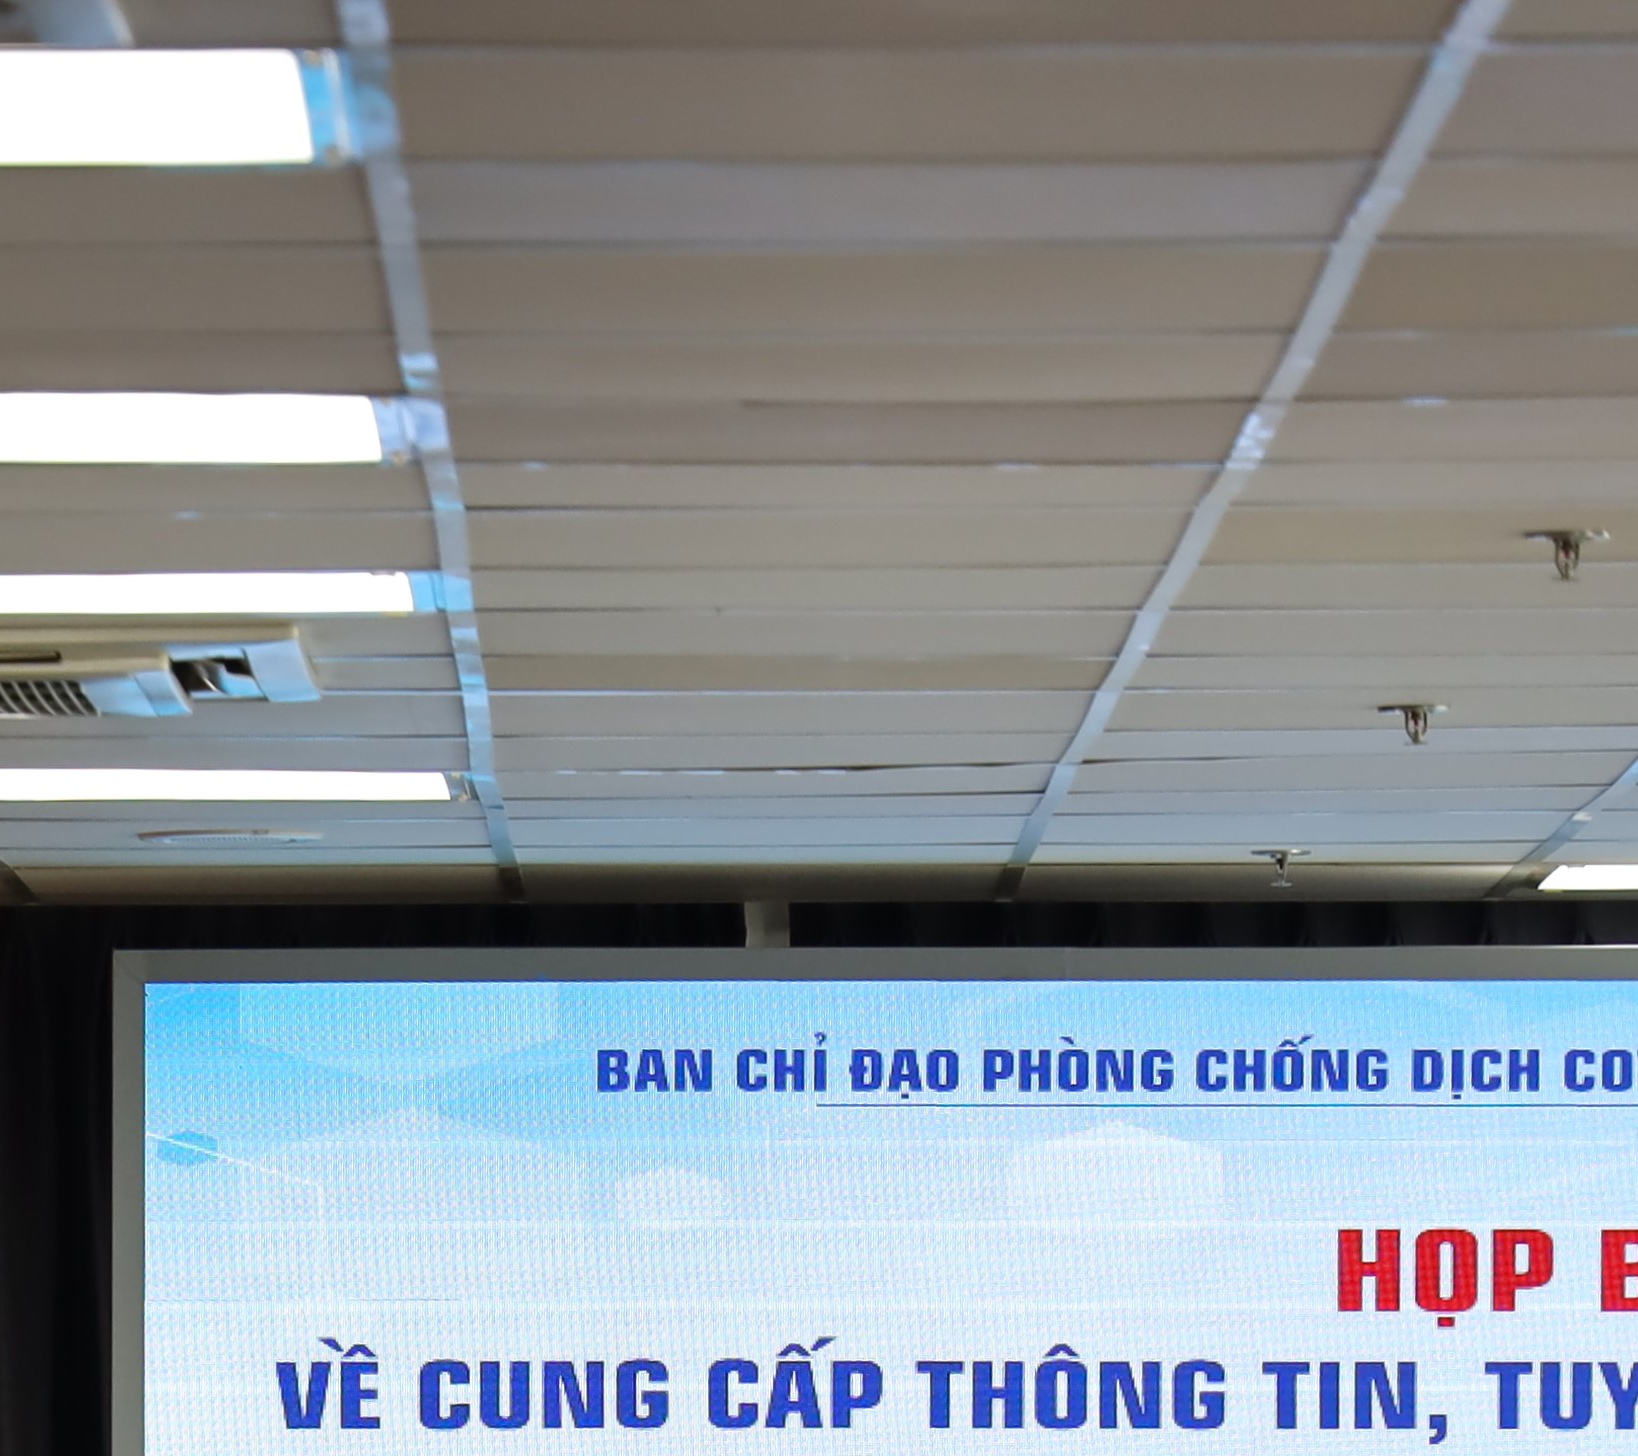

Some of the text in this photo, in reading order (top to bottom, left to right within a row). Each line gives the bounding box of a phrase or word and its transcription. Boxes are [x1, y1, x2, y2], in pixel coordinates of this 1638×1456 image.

[595, 1048, 713, 1093] BAN
[735, 1031, 828, 1092] CHỈ
[848, 1048, 960, 1099] ĐẠO
[982, 1036, 1175, 1093] PHÒNG
[1194, 1035, 1389, 1092] CHỐNG
[1411, 1048, 1541, 1100] DỊCH
[1337, 1227, 1555, 1328] HỌP
[275, 1337, 382, 1430] VỀ
[418, 1358, 670, 1431] CUNG
[707, 1336, 884, 1430] CẤP
[915, 1344, 1227, 1430] THÔNG
[1262, 1360, 1449, 1443] TIN,
